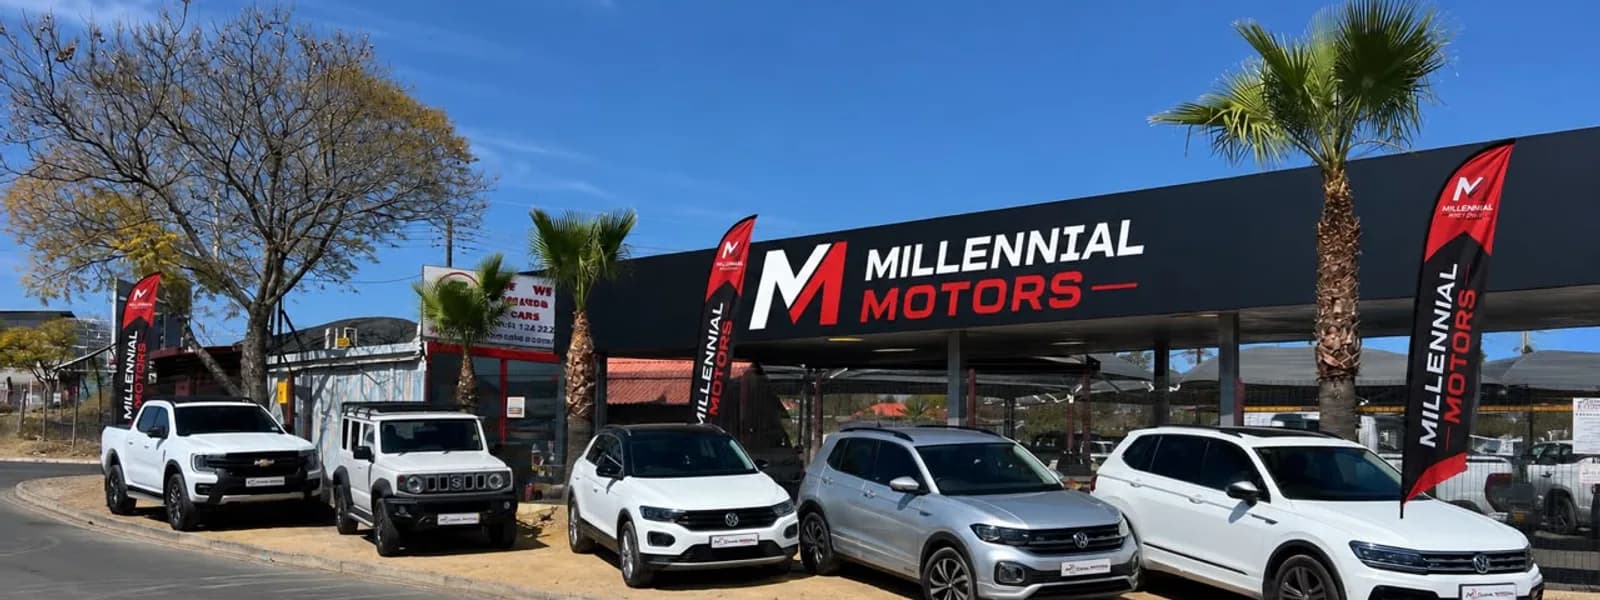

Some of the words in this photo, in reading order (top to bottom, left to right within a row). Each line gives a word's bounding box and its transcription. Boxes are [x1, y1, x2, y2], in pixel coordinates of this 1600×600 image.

[864, 219, 1144, 281] MILLENNIAL
[860, 271, 1083, 324] MOTORS
[123, 330, 139, 419] MILLENNIAL
[134, 343, 147, 409] MOTORS
[709, 320, 733, 416] MOTORS
[1420, 263, 1458, 448] MILLENNIAL
[1444, 288, 1477, 424] MOTORS
